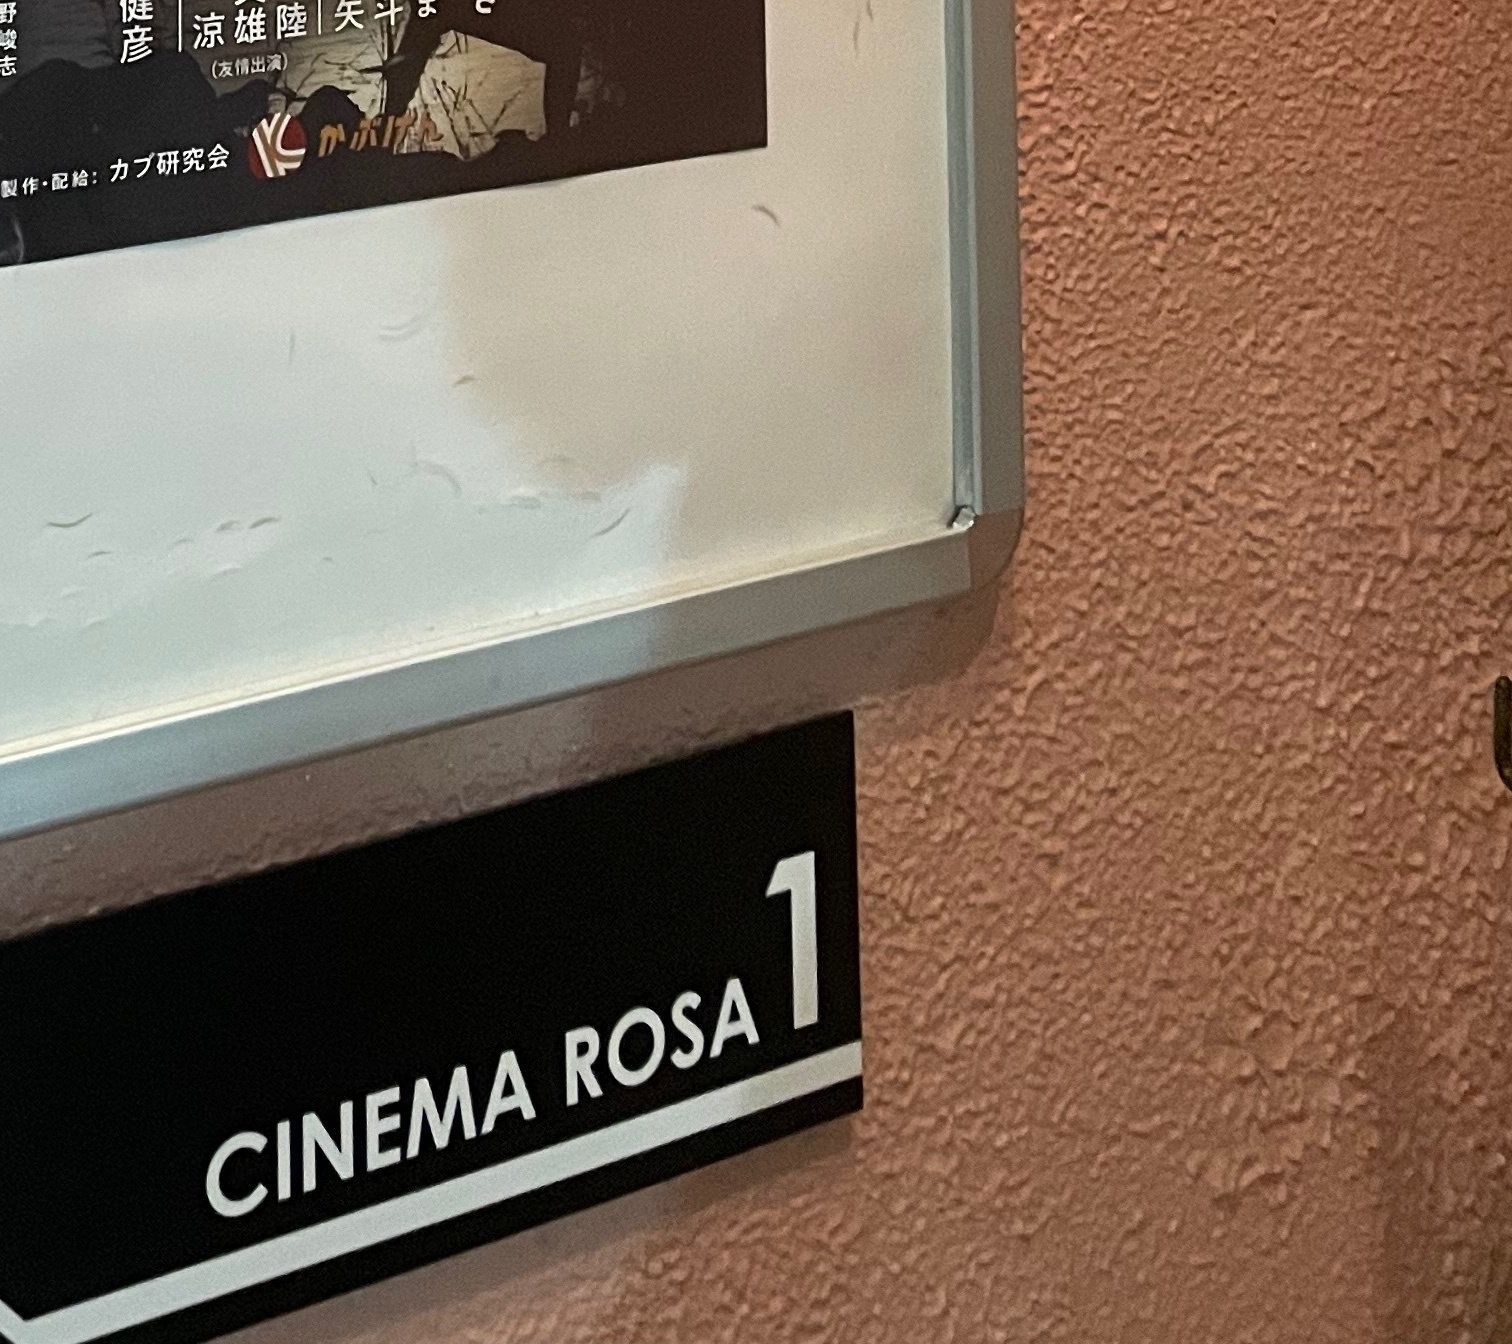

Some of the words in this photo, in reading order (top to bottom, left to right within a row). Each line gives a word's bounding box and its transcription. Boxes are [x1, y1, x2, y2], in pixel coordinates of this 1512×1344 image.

[211, 52, 288, 79] (友情出演)
[205, 1051, 537, 1218] CINEMA
[565, 977, 760, 1107] ROSA
